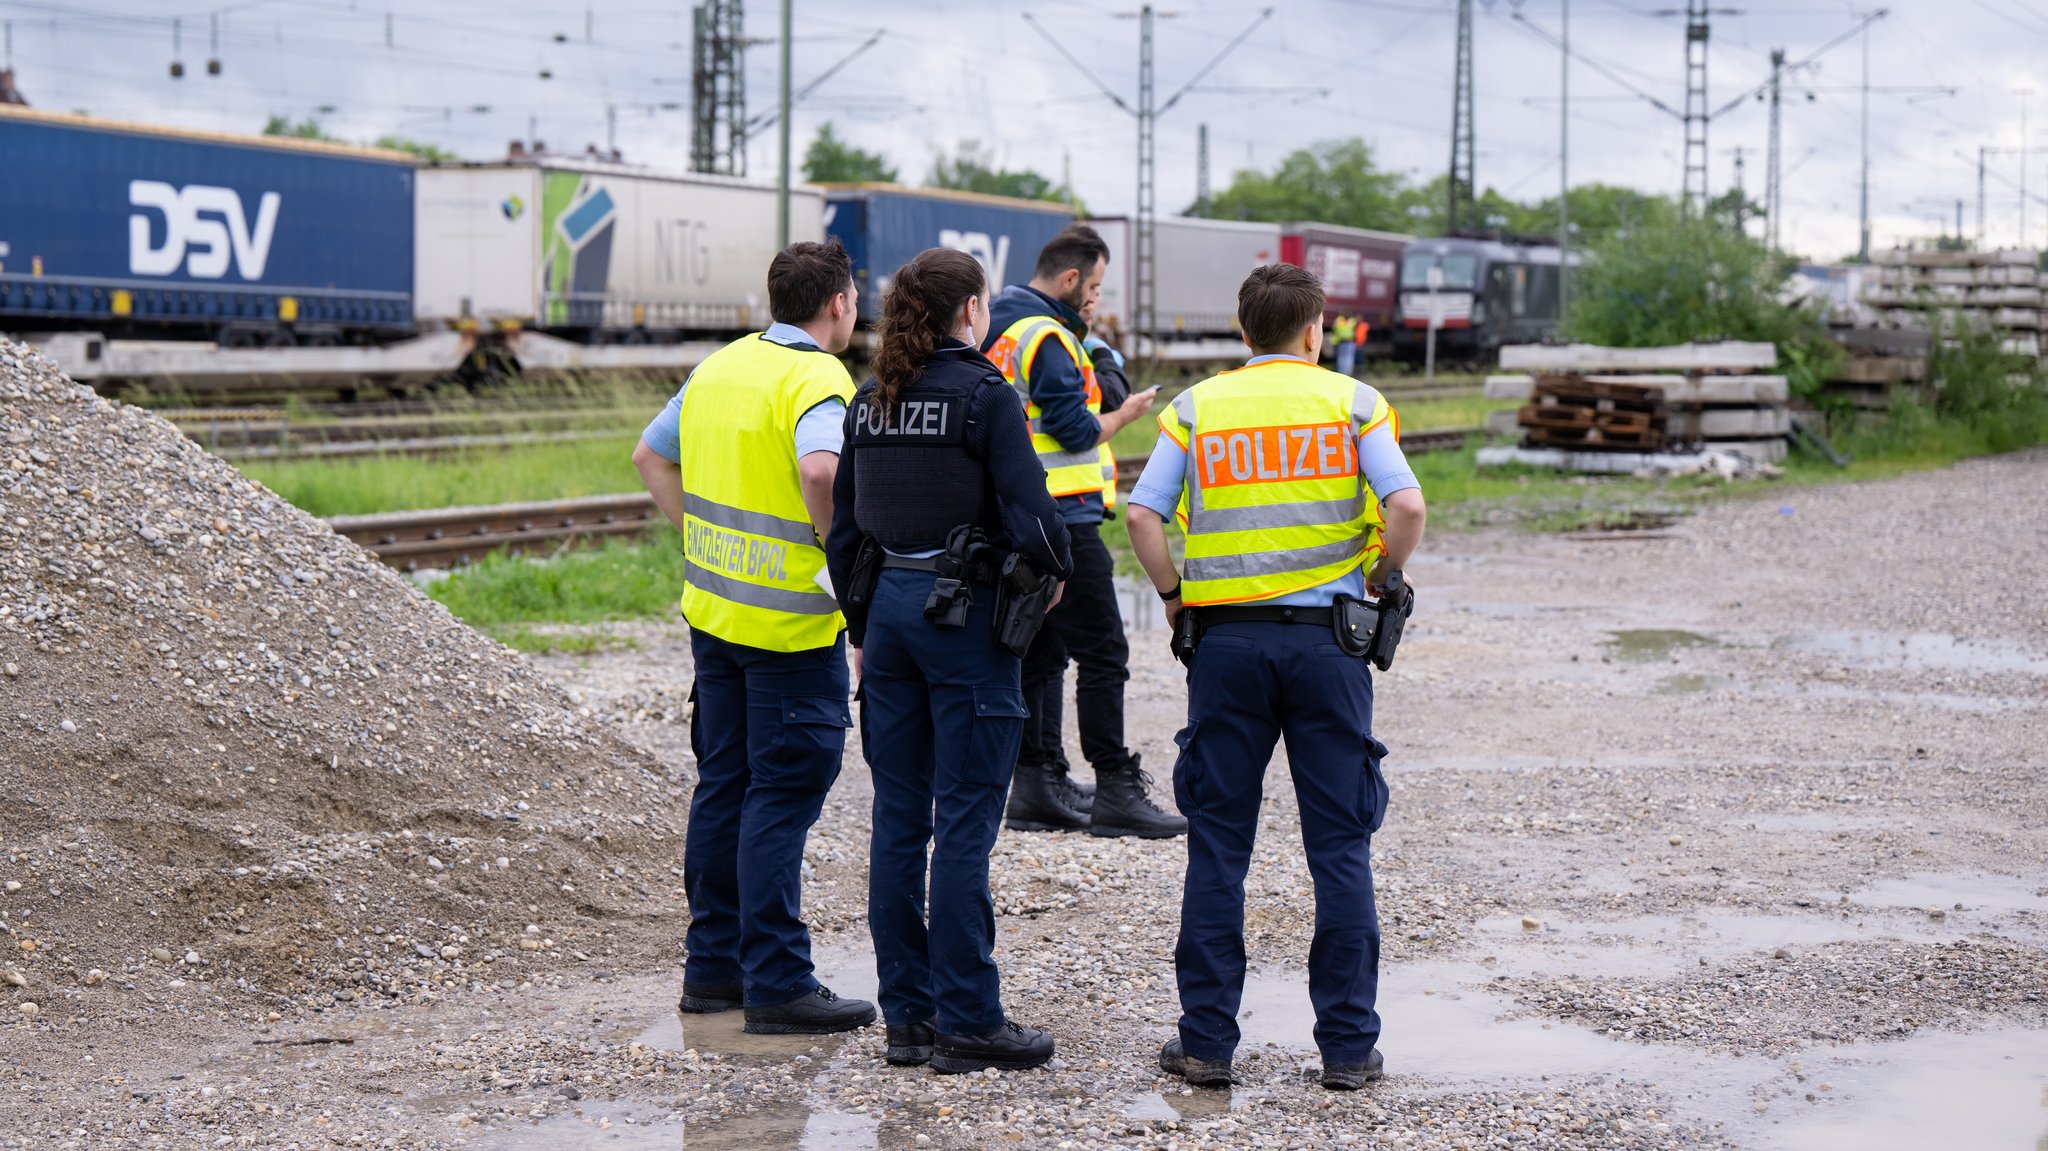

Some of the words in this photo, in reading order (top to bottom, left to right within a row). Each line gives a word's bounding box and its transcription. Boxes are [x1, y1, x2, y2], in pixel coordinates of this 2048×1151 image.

[129, 180, 281, 281] DSV
[655, 218, 711, 286] NTG
[855, 402, 948, 435] POLIZEI
[1202, 426, 1353, 484] POLIZEI
[747, 539, 787, 581] BPOL
